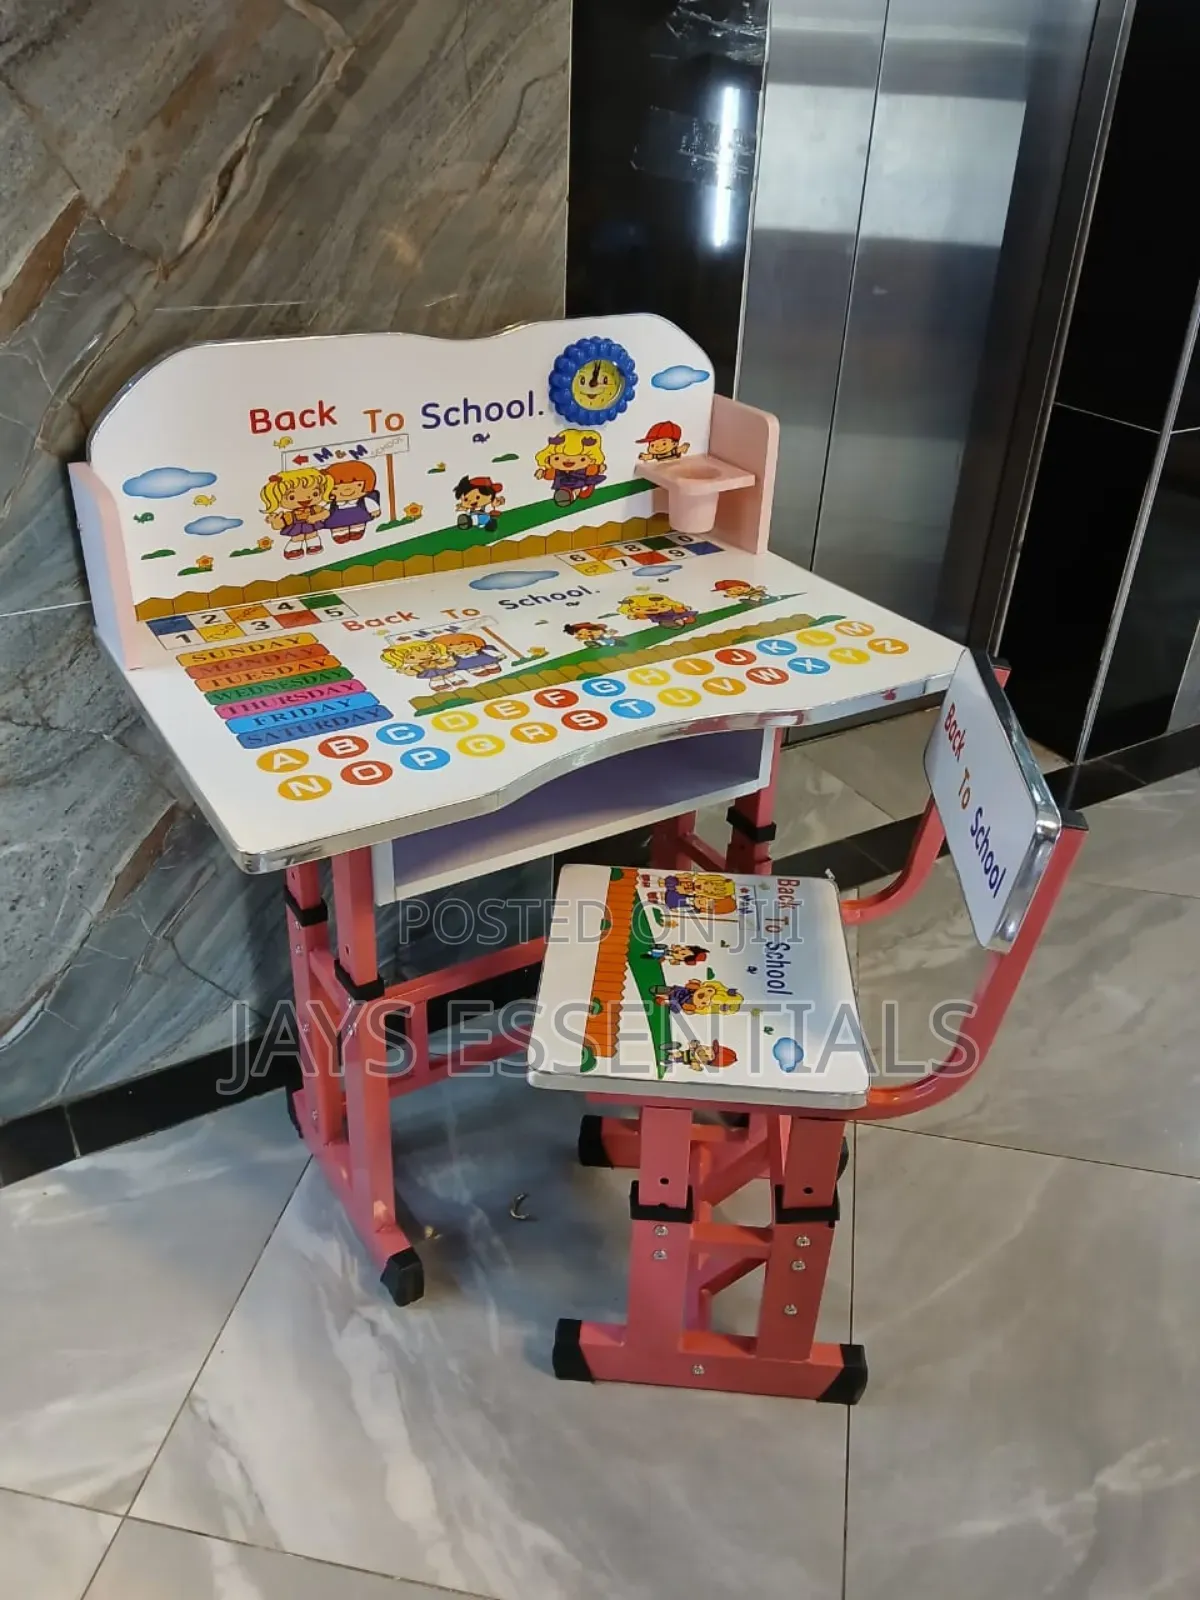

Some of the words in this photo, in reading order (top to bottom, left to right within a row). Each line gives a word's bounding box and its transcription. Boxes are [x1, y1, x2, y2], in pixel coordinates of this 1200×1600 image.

[249, 400, 337, 434] Back
[363, 408, 405, 433] To
[421, 390, 545, 429] School.
[313, 447, 333, 463] M
[349, 444, 368, 460] M
[570, 554, 586, 562] 6
[624, 544, 641, 552] 8
[668, 549, 685, 557] 9
[614, 559, 628, 567] 7
[201, 614, 221, 625] 2
[277, 602, 295, 611] 4
[325, 608, 344, 618] 5
[342, 611, 420, 631] Back
[441, 608, 480, 620] To
[499, 585, 601, 610] School.
[175, 634, 192, 644] 1
[251, 620, 271, 631] 3
[192, 635, 303, 662] SUNDAY
[201, 645, 315, 675] MONDAY
[205, 657, 329, 689] TUESDAY
[211, 669, 347, 702] WEDNESDAY
[222, 682, 357, 715] THURSDAY
[272, 752, 301, 770] A
[331, 738, 359, 755] B
[387, 727, 414, 741] C
[444, 714, 467, 728] D
[496, 703, 520, 717] E
[545, 692, 569, 704] F
[591, 682, 617, 694] G
[637, 671, 661, 684] H
[766, 641, 788, 652] K
[840, 622, 869, 636] M
[248, 708, 386, 745] SATURDAY
[253, 698, 354, 727] FRIDAY
[288, 778, 323, 796] N
[352, 764, 383, 781] O
[411, 751, 437, 766] P
[467, 738, 495, 752] Q
[521, 725, 549, 740] R
[572, 713, 597, 727] S
[620, 701, 642, 715] T
[669, 691, 692, 703] U
[711, 679, 733, 692] V
[754, 669, 782, 682] W
[798, 660, 821, 672] X
[838, 650, 859, 662] Y
[877, 640, 902, 653] Z
[944, 703, 967, 763] Back
[958, 766, 972, 810] To
[970, 806, 1007, 899] School
[777, 879, 800, 909] Back
[765, 916, 789, 933] To
[766, 941, 794, 995] School
